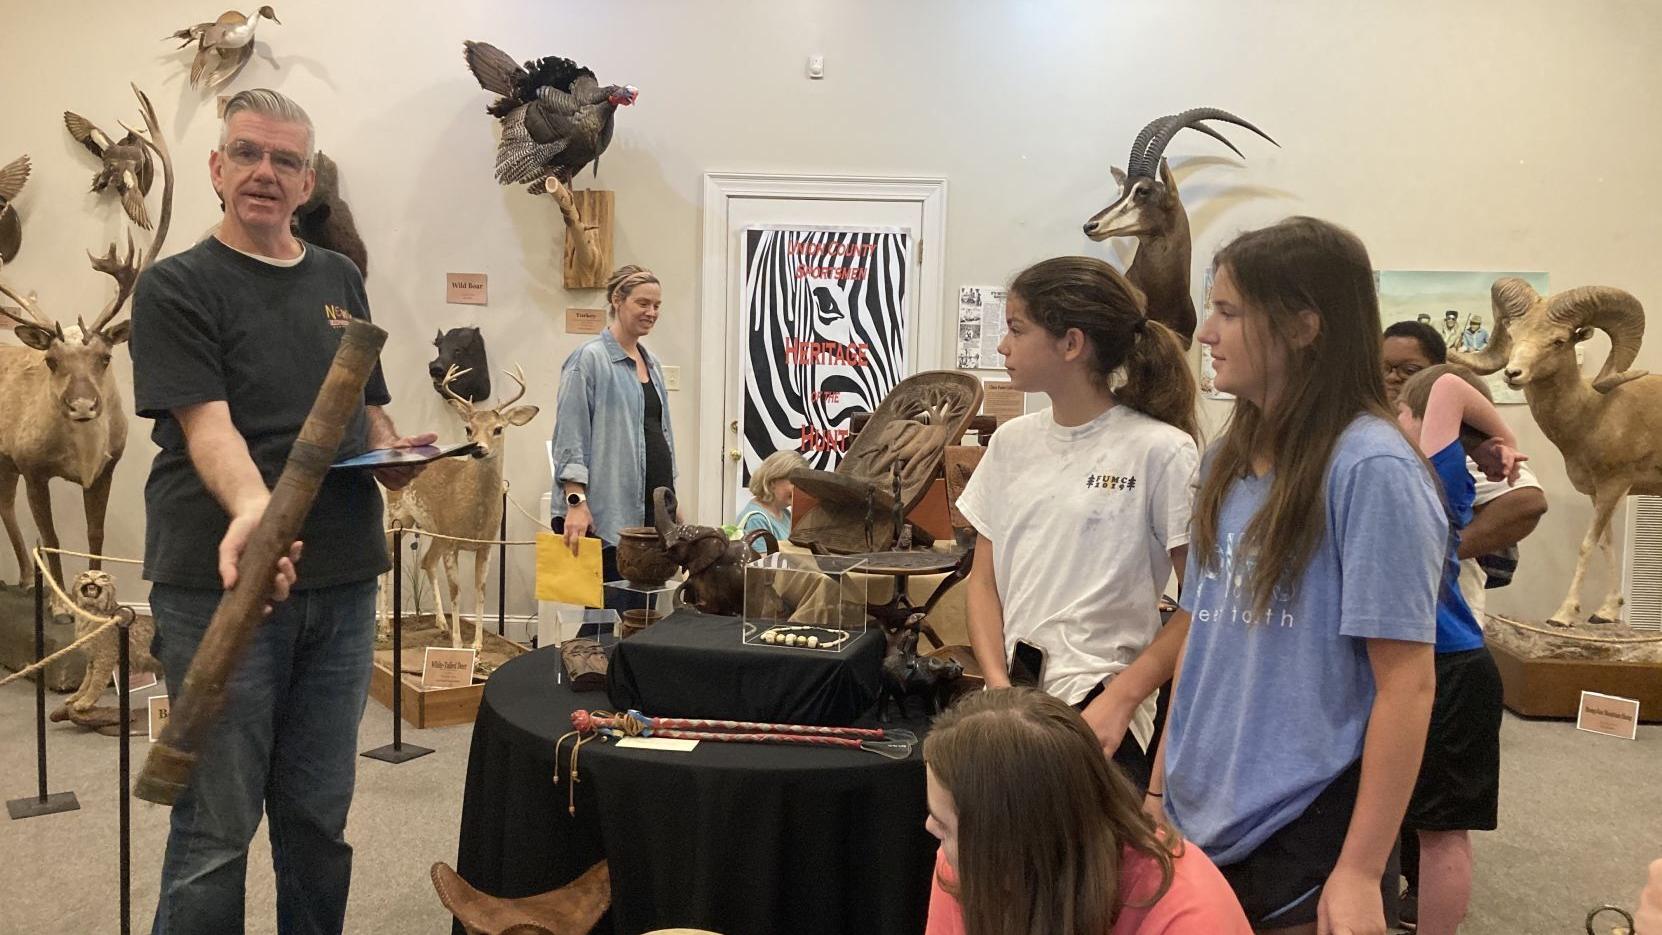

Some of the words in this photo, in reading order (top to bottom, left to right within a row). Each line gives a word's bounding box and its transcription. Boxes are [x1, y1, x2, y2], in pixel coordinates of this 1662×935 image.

[787, 239, 824, 256] UNION
[827, 241, 877, 257] COUNTY
[794, 263, 869, 281] SPORTSMEN
[451, 281, 467, 289] Wild
[784, 336, 869, 367] HERITAGE
[810, 391, 823, 403] OF
[824, 391, 841, 404] THE
[801, 424, 849, 452] HUNT
[1096, 475, 1128, 483] FUMC
